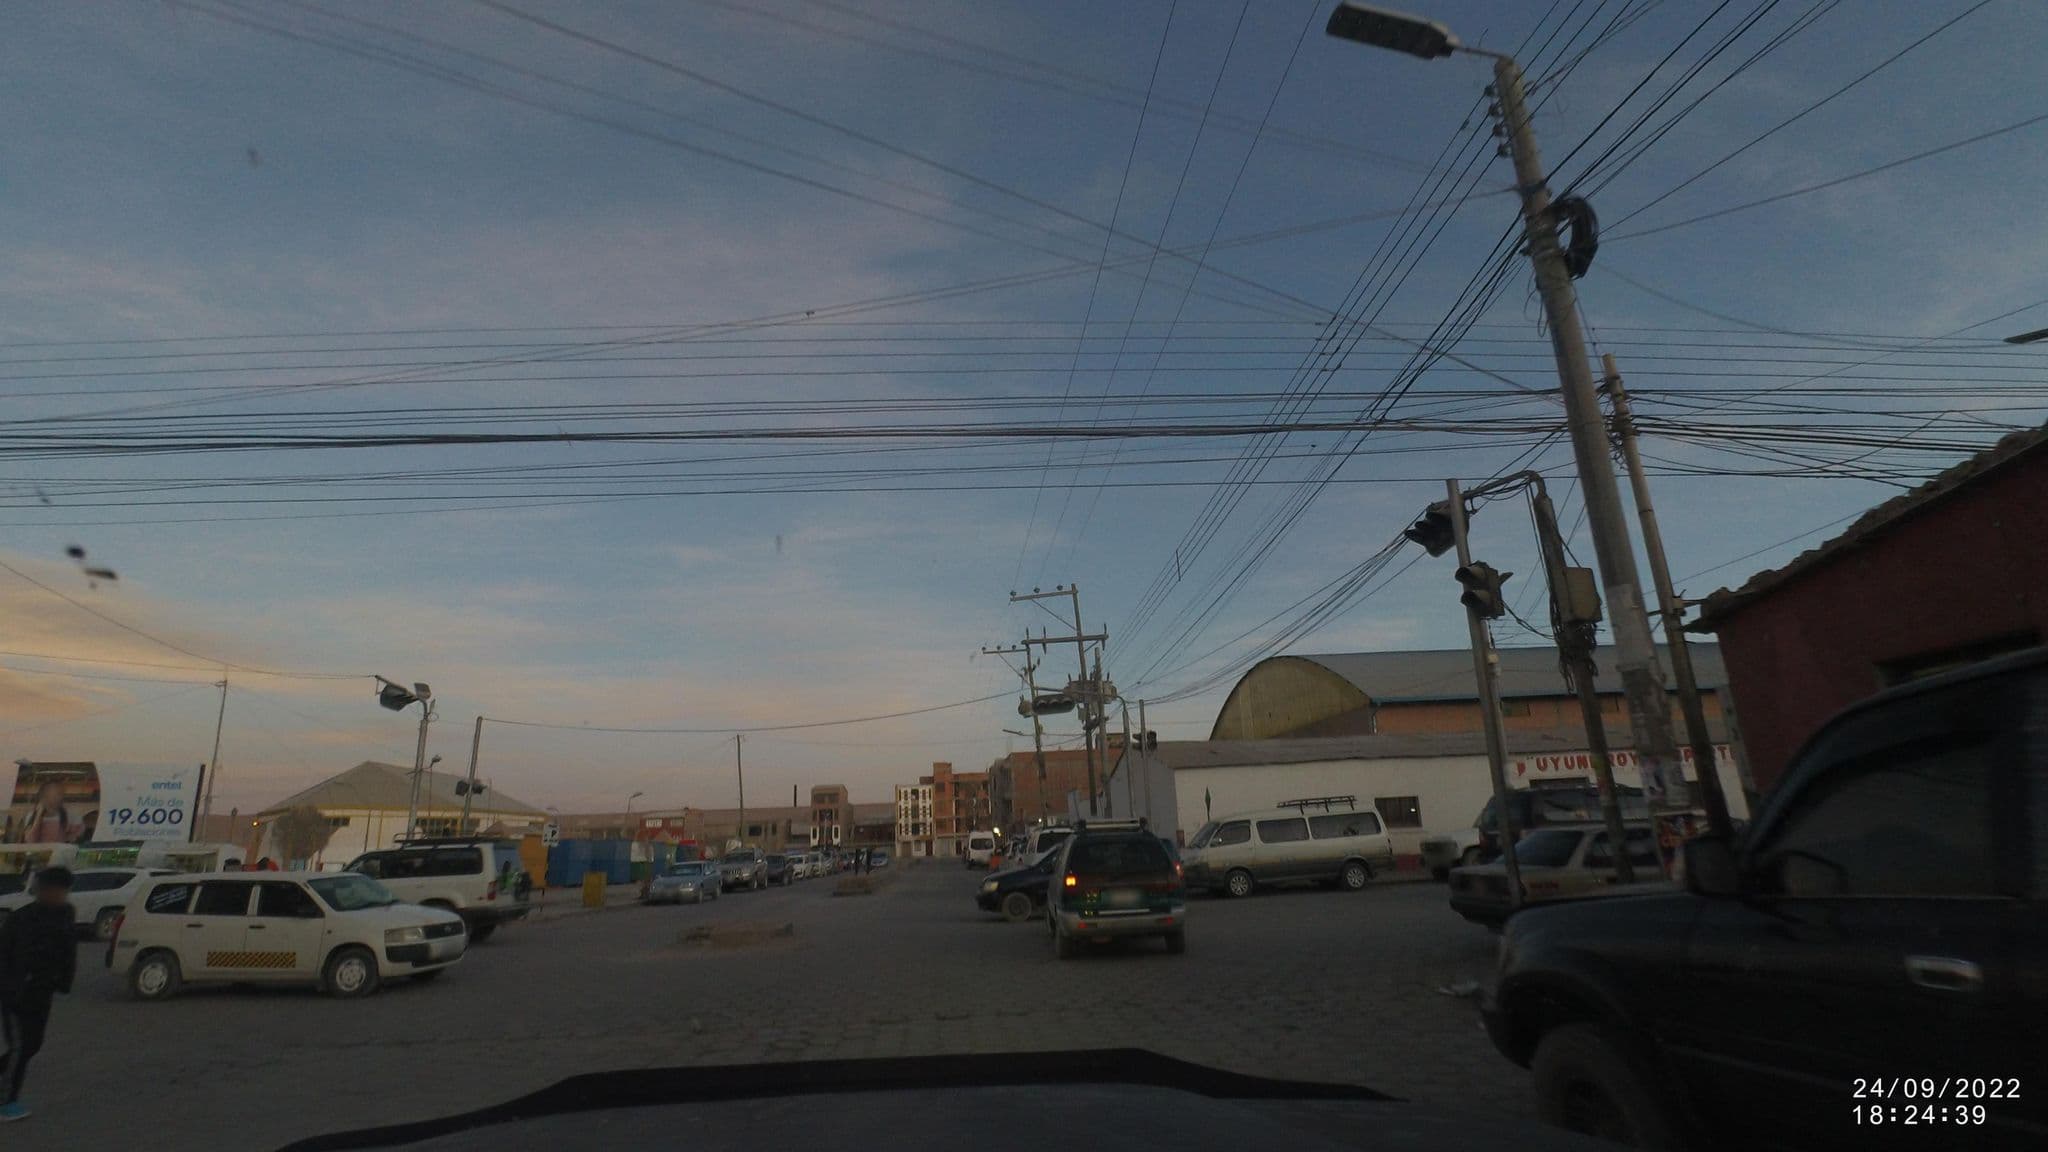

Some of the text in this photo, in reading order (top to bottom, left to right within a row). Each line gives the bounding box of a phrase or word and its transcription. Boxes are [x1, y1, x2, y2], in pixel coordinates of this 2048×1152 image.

[151, 781, 182, 790] entel
[167, 797, 184, 807] de
[109, 808, 183, 825] 19.600
